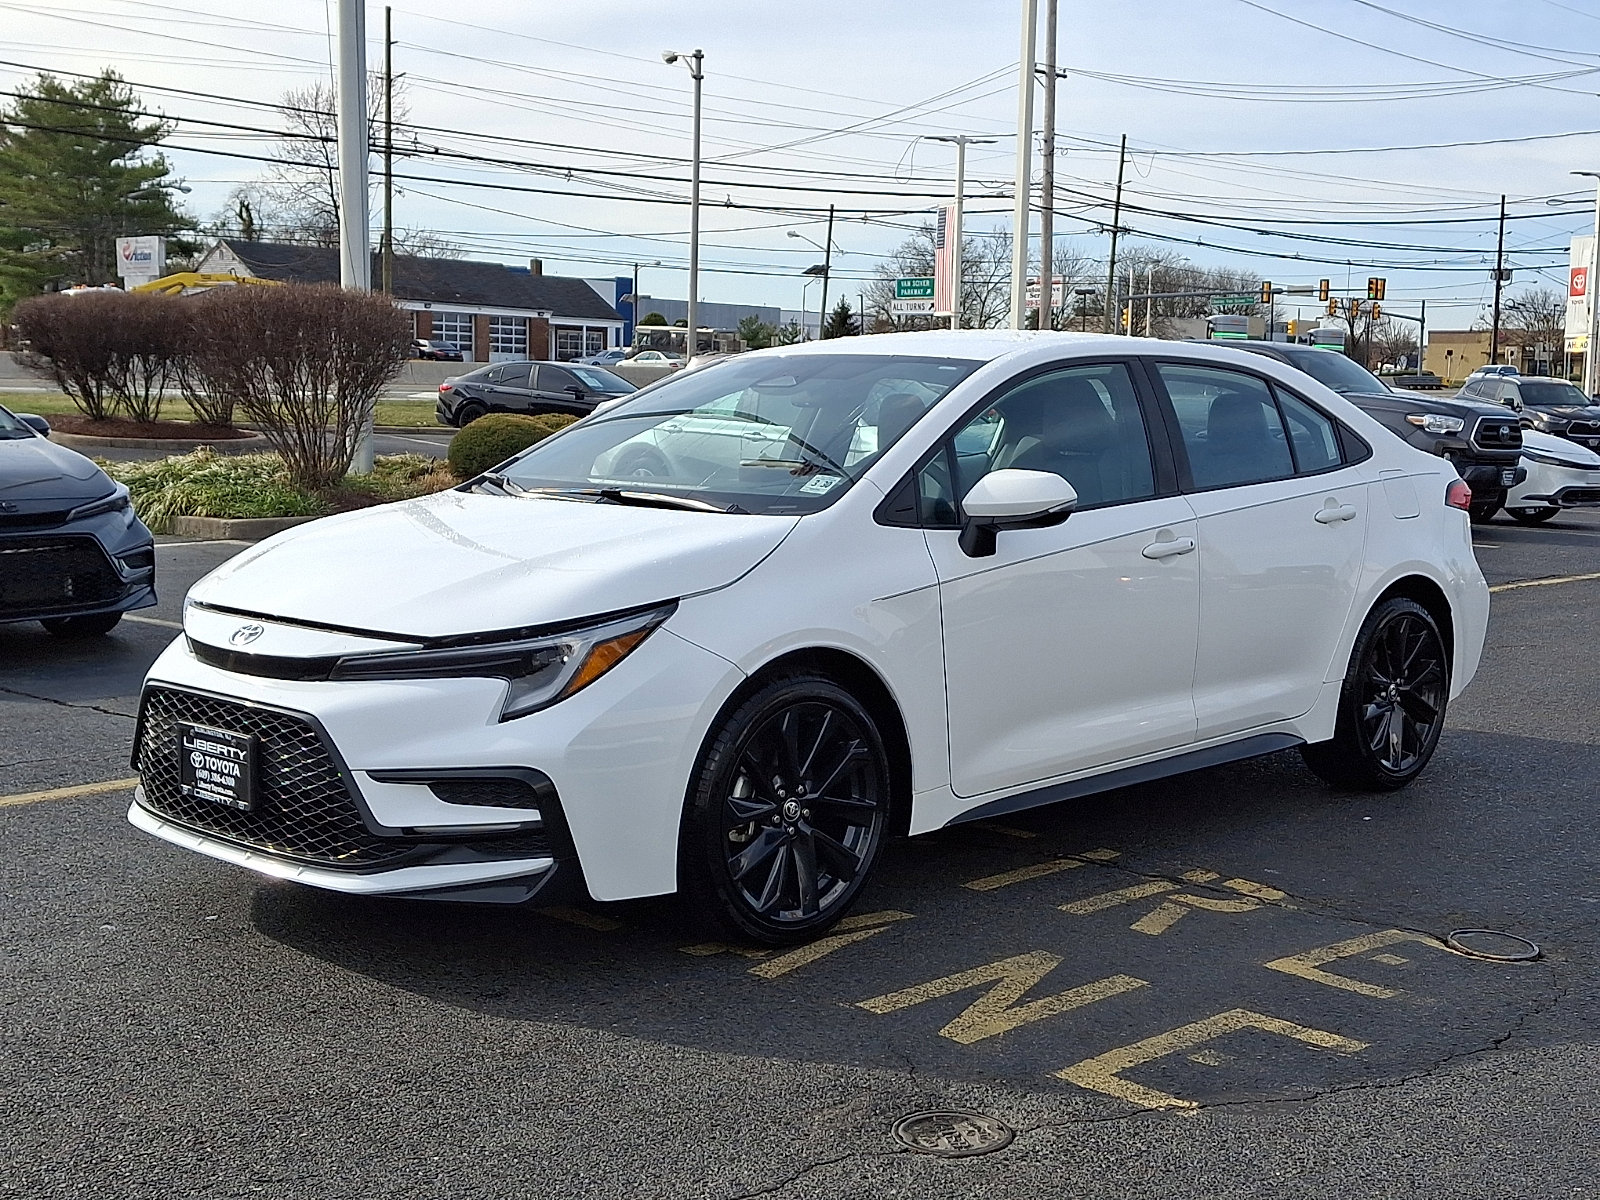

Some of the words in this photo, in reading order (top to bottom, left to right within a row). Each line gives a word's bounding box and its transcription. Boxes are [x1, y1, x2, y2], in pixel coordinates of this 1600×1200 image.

[892, 303, 904, 311] ALL
[906, 303, 926, 311] TURNS
[1567, 341, 1588, 349] AHAD
[183, 735, 247, 761] LIBERTY
[204, 755, 241, 778] TOYOTA
[960, 822, 1542, 999] IRE
[536, 903, 1370, 1113] ANE
